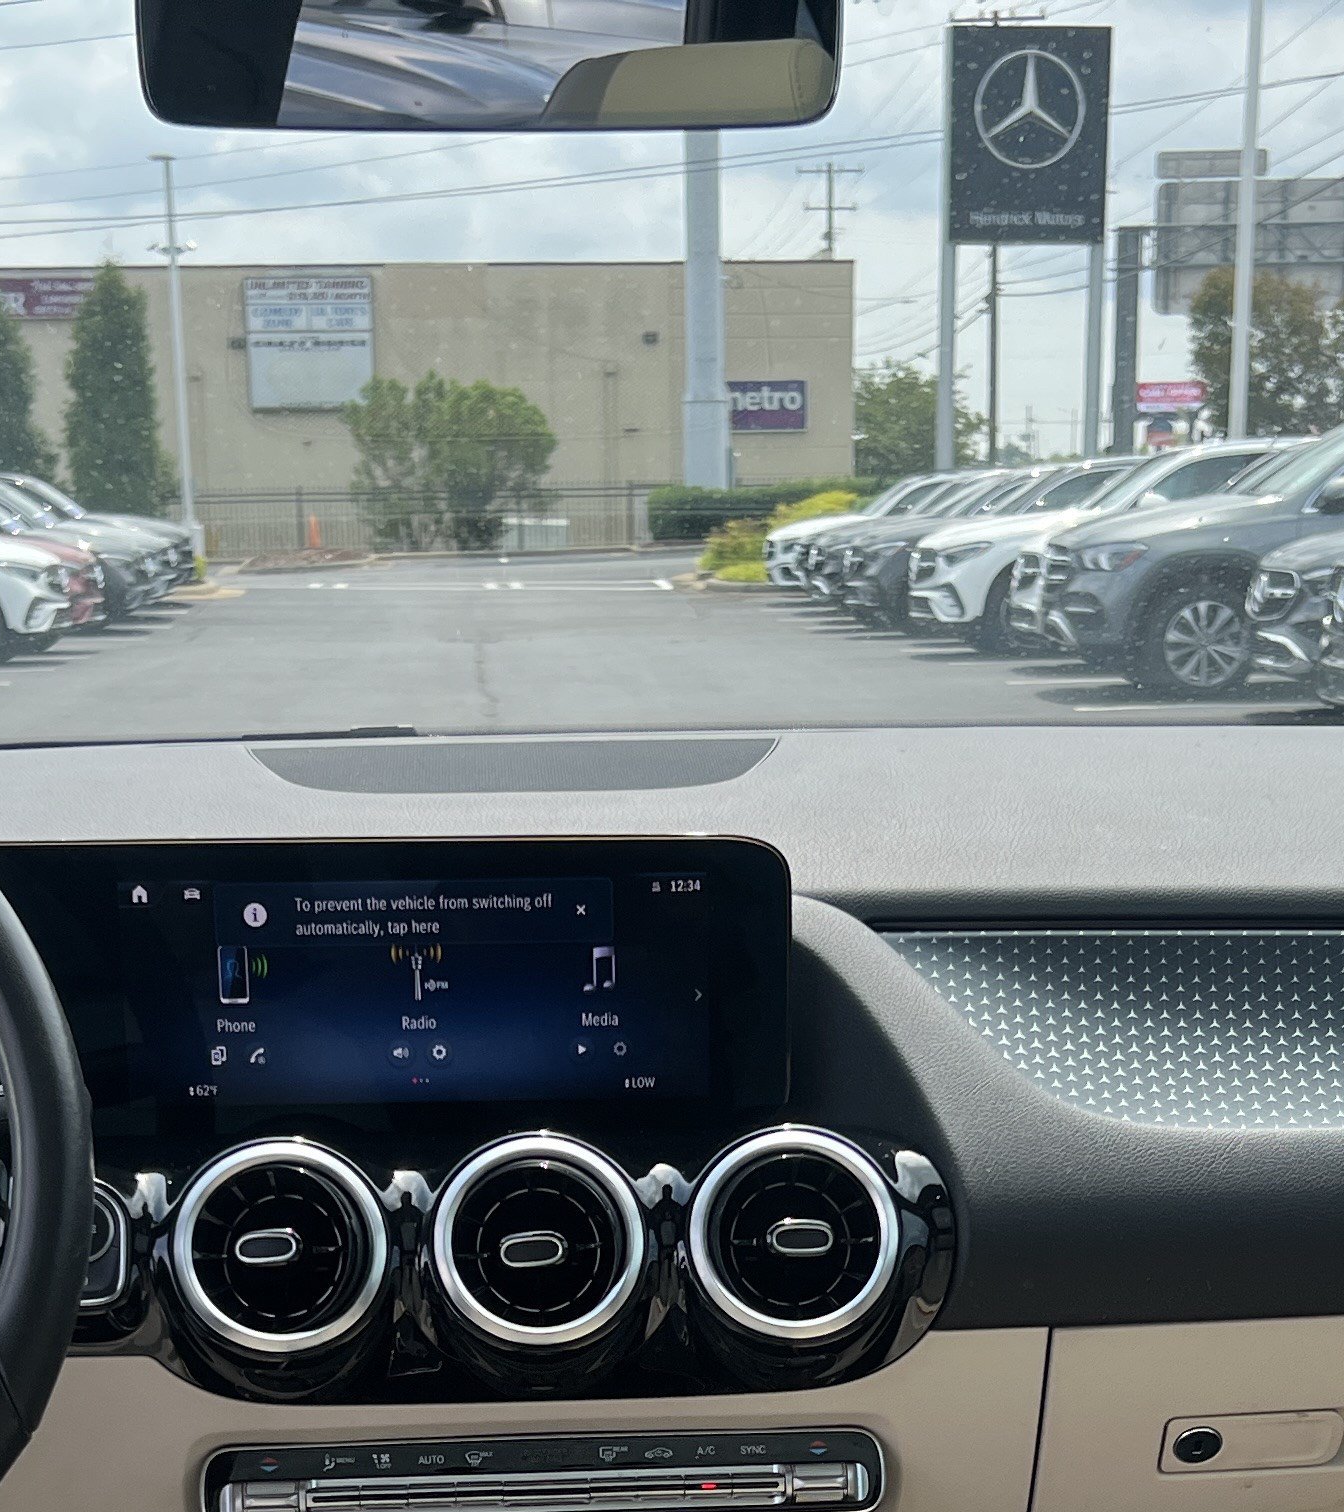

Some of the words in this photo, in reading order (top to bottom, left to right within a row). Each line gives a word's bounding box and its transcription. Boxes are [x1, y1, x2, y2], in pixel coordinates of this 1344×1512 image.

[670, 879, 701, 892] 12:34
[294, 898, 311, 912] To
[314, 898, 363, 915] prevent
[366, 897, 387, 911] the
[390, 896, 436, 910] vehicle
[438, 895, 469, 910] from
[472, 894, 532, 911] switching
[534, 893, 552, 909] off
[295, 920, 384, 938] automatically,
[387, 921, 407, 937] tap
[411, 919, 440, 934] here
[216, 1018, 256, 1033] Phone
[401, 1015, 437, 1030] Radio
[581, 1012, 619, 1027] Media
[631, 1076, 656, 1089] LOW
[696, 1445, 716, 1456] A/C
[740, 1444, 766, 1456] SYNC
[418, 1453, 445, 1466] AUTO
